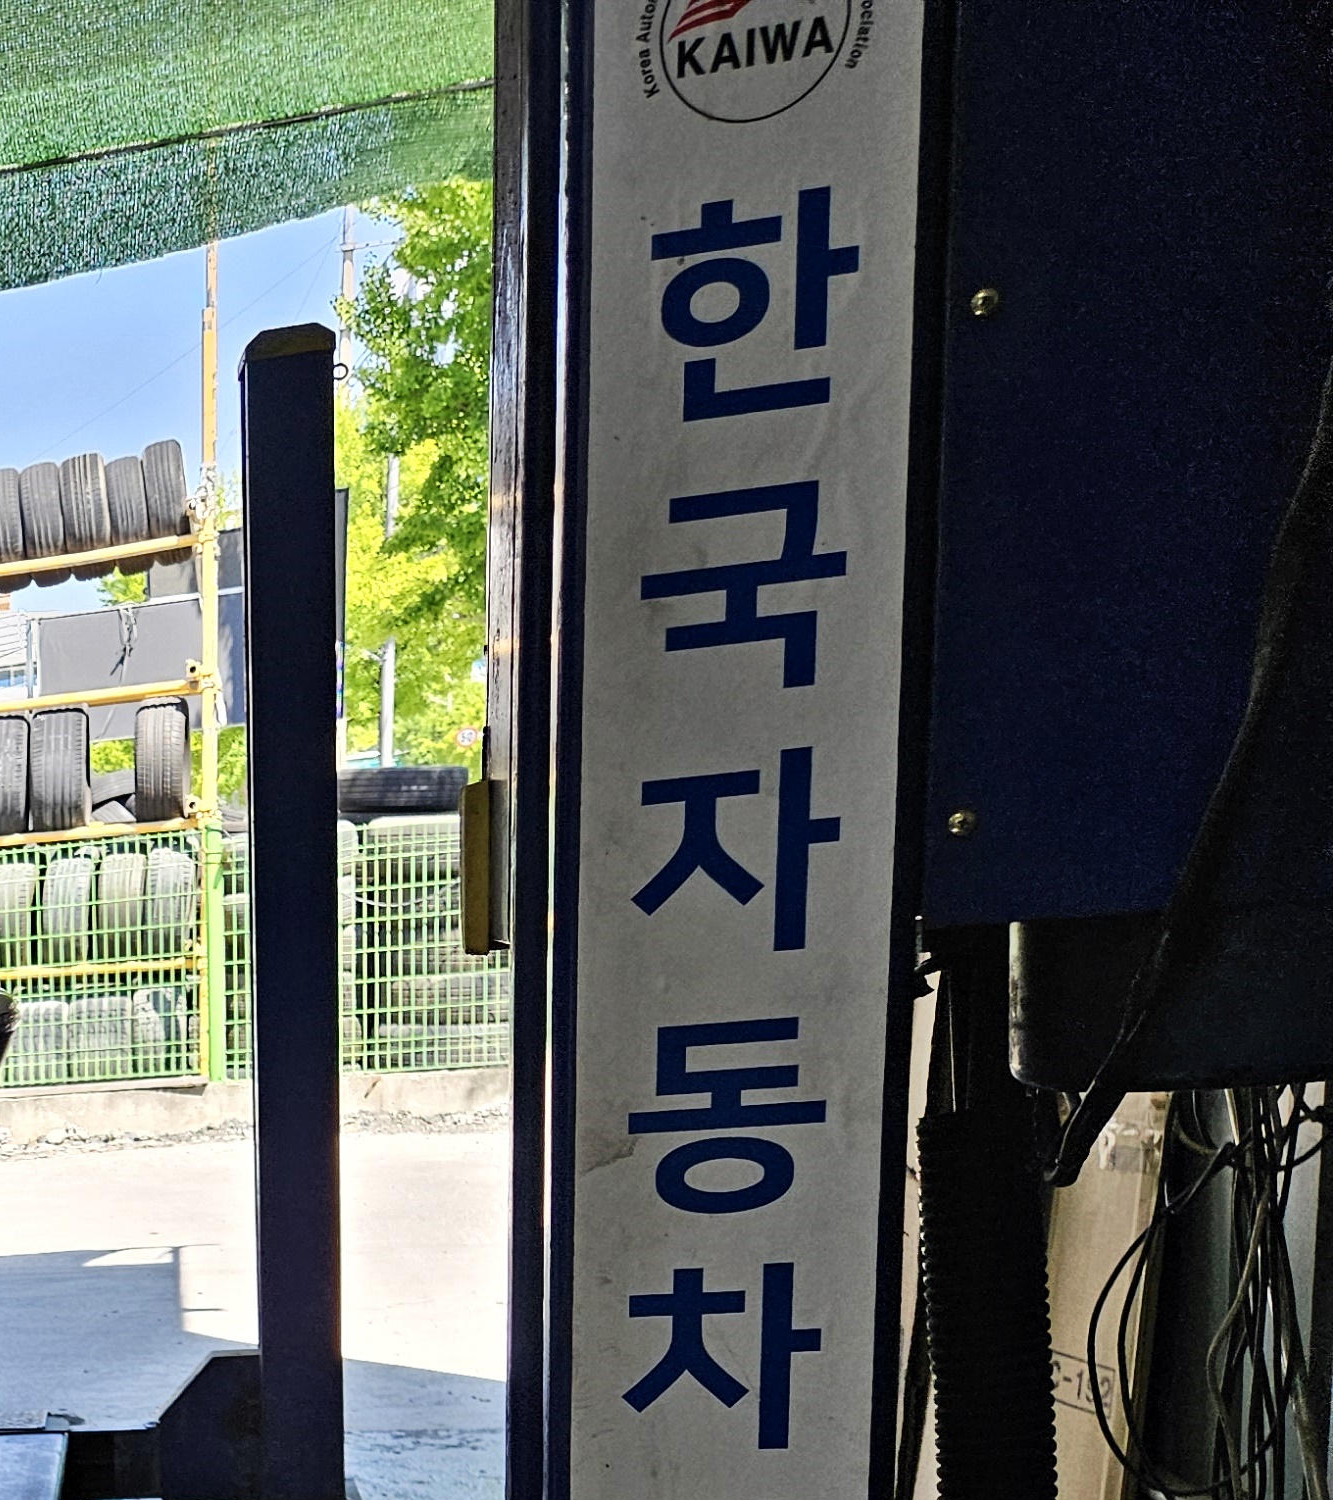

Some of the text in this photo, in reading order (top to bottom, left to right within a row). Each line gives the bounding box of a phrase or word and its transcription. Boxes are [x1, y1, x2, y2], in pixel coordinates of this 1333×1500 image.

[636, 0, 874, 98] Korea Auto ociation
[676, 15, 834, 79] KAIWA
